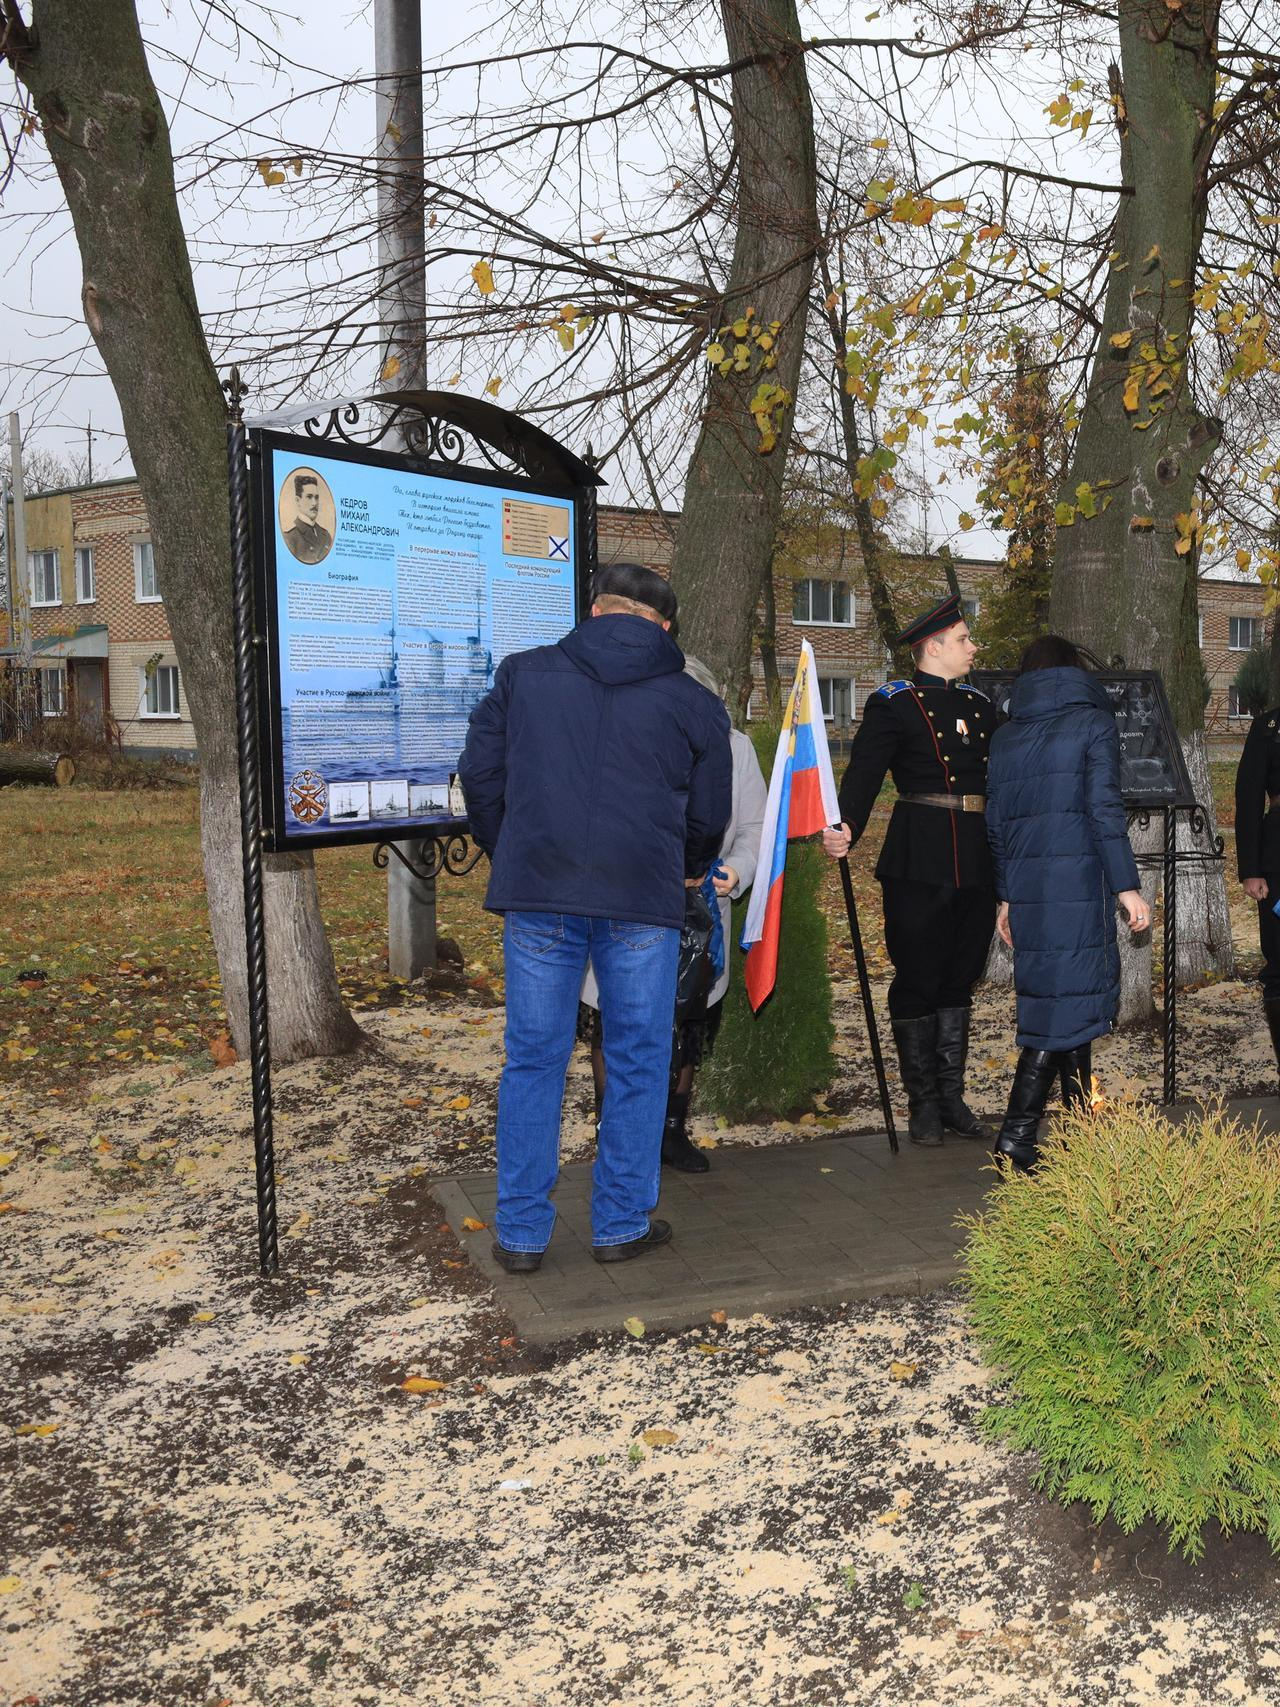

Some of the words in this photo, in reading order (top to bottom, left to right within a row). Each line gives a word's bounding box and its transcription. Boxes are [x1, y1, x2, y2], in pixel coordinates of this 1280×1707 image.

[340, 497, 368, 510] КЕДРОВ
[340, 510, 370, 522] МИХАИЛ
[340, 522, 400, 537] АЛЕКСАНДРОВИЧ
[409, 544, 414, 552] В
[414, 546, 439, 555] перерыве
[440, 549, 457, 558] между
[457, 551, 479, 559] войнами
[504, 561, 530, 571] Последний
[530, 566, 561, 574] командующий
[327, 571, 359, 582] Биография
[402, 640, 424, 650] Участие
[428, 642, 447, 651] Первой
[448, 644, 469, 652] мировой
[295, 688, 319, 697] Участие
